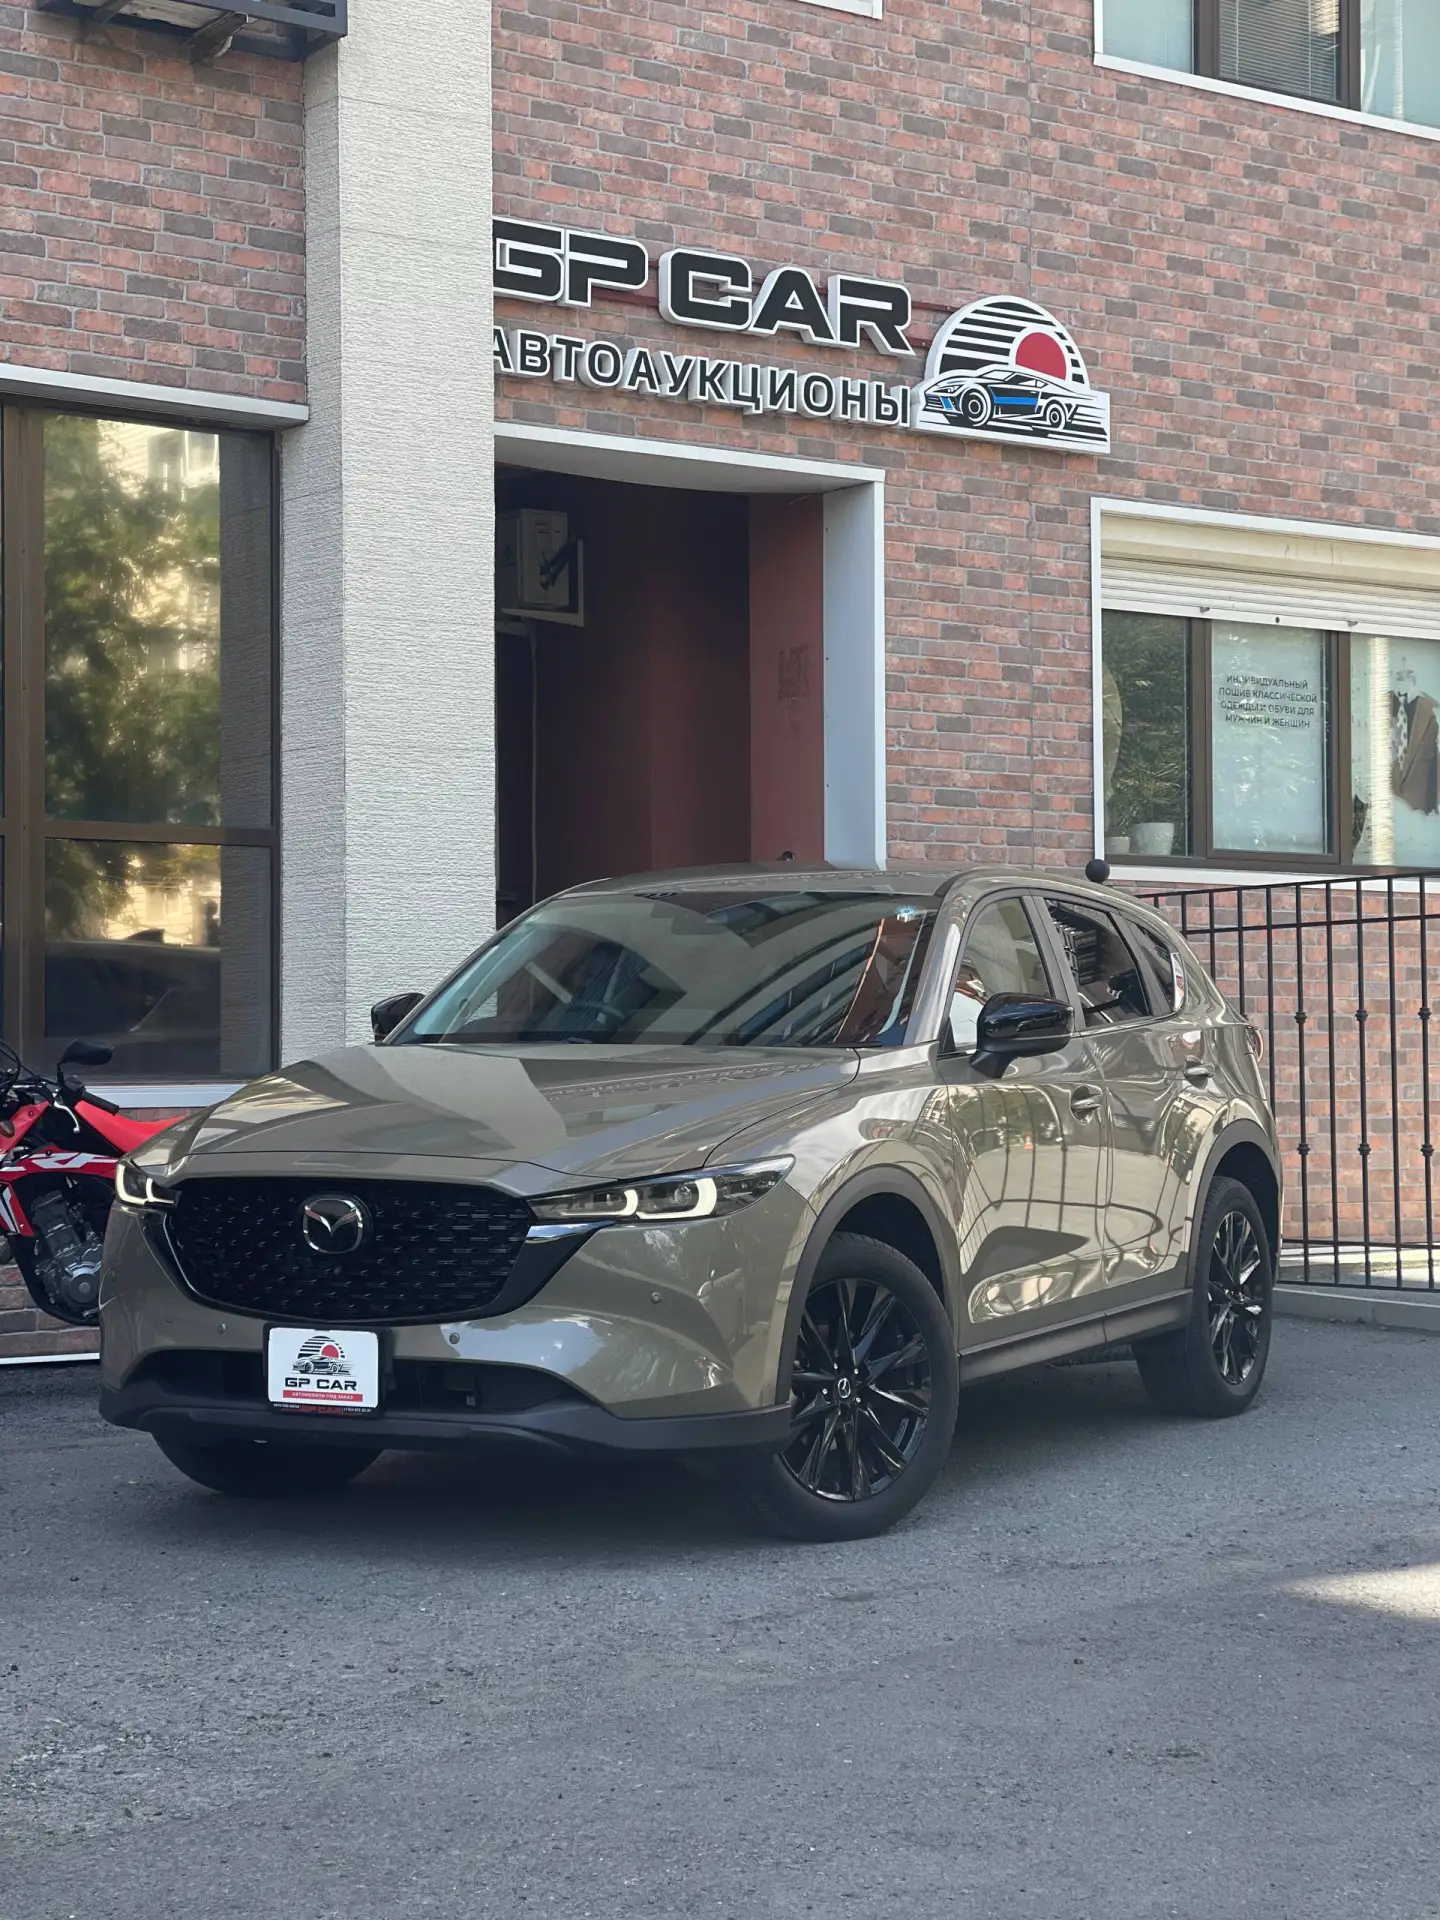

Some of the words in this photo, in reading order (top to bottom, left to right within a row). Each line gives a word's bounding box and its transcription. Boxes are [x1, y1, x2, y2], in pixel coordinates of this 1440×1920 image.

[492, 215, 648, 308] GP
[660, 247, 916, 356] CAR
[493, 325, 911, 429] АВТОАУКЦИОНЫ
[1226, 675, 1308, 689] ИНДИВИДУАЛЬНЫЙ
[1219, 687, 1251, 698] ПОШИВ
[1252, 690, 1317, 703] КЛАССИЧЕСКОЙ
[1220, 700, 1259, 712] ОДЕЖДЫ
[1268, 704, 1296, 714] ОБУВИ
[1297, 706, 1315, 716] ДЛЯ
[1225, 714, 1262, 725] МУЖЧИН
[1264, 717, 1270, 725] И
[1271, 719, 1310, 728] ЖЕНЩИН
[285, 1377, 310, 1388] GP
[316, 1379, 357, 1391] CAR
